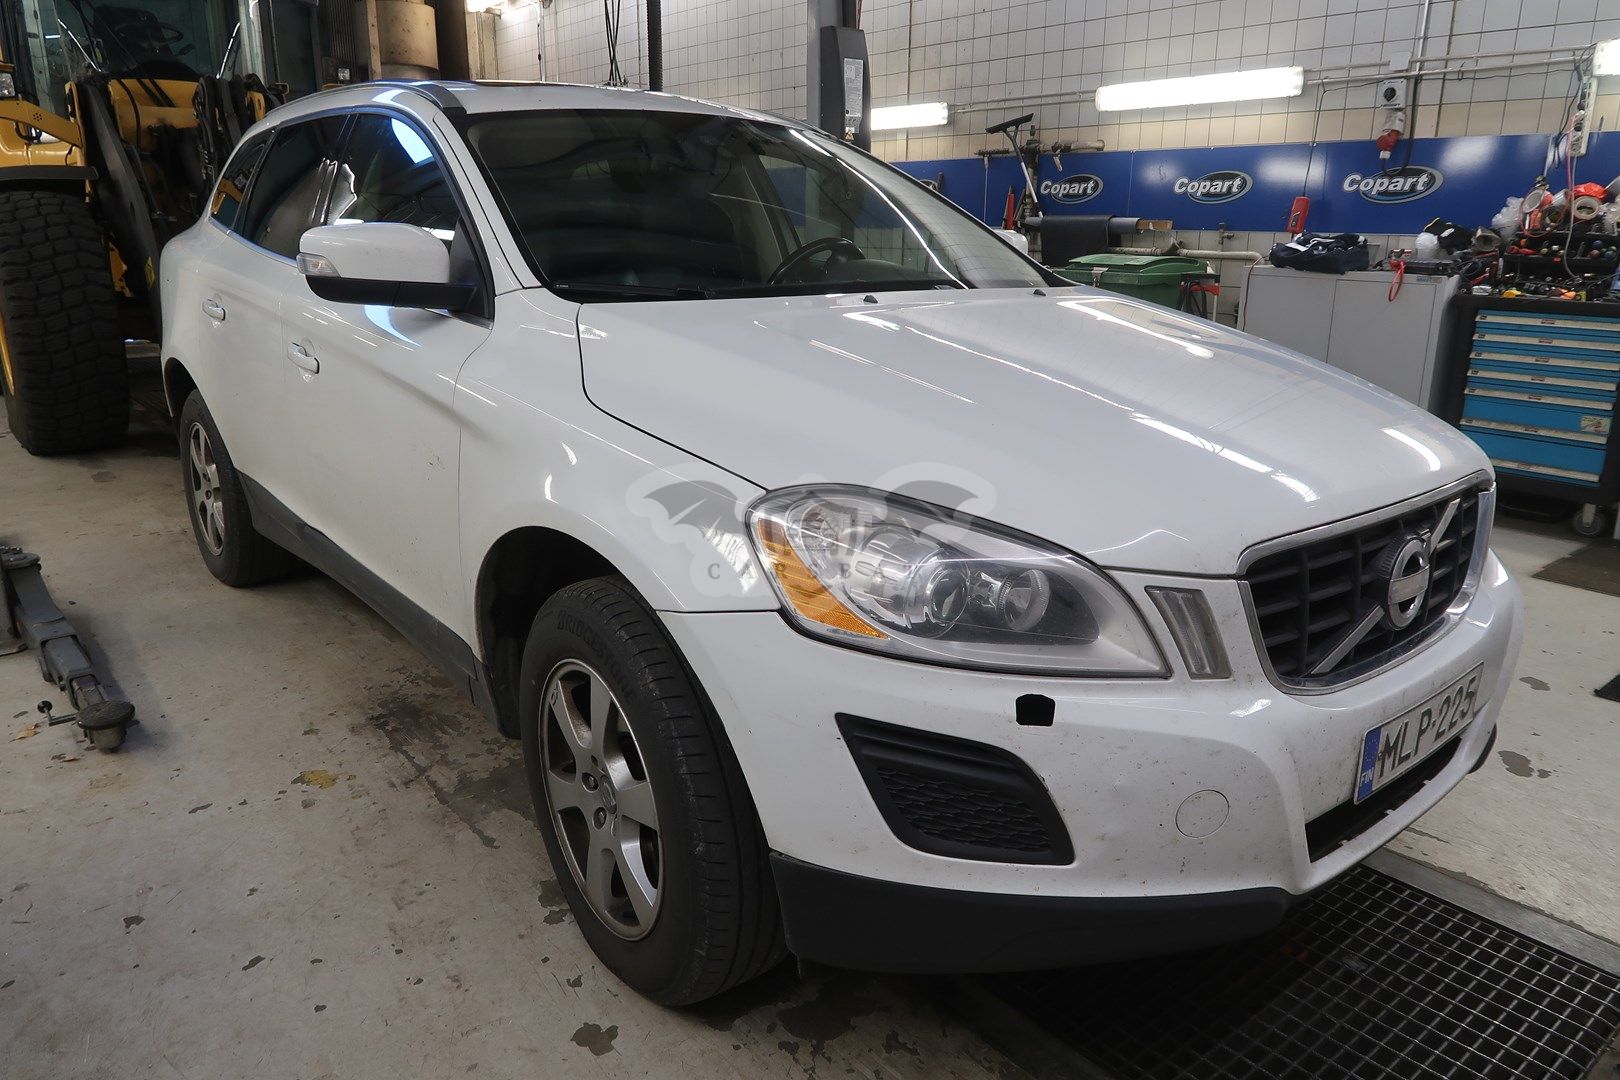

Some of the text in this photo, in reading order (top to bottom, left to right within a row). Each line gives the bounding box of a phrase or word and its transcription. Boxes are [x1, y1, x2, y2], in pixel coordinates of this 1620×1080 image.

[1040, 180, 1094, 197] Copart
[1174, 177, 1242, 196] Copart
[1343, 173, 1428, 195] Copart
[1378, 676, 1477, 779] MLP-225
[1360, 767, 1374, 787] FIN
